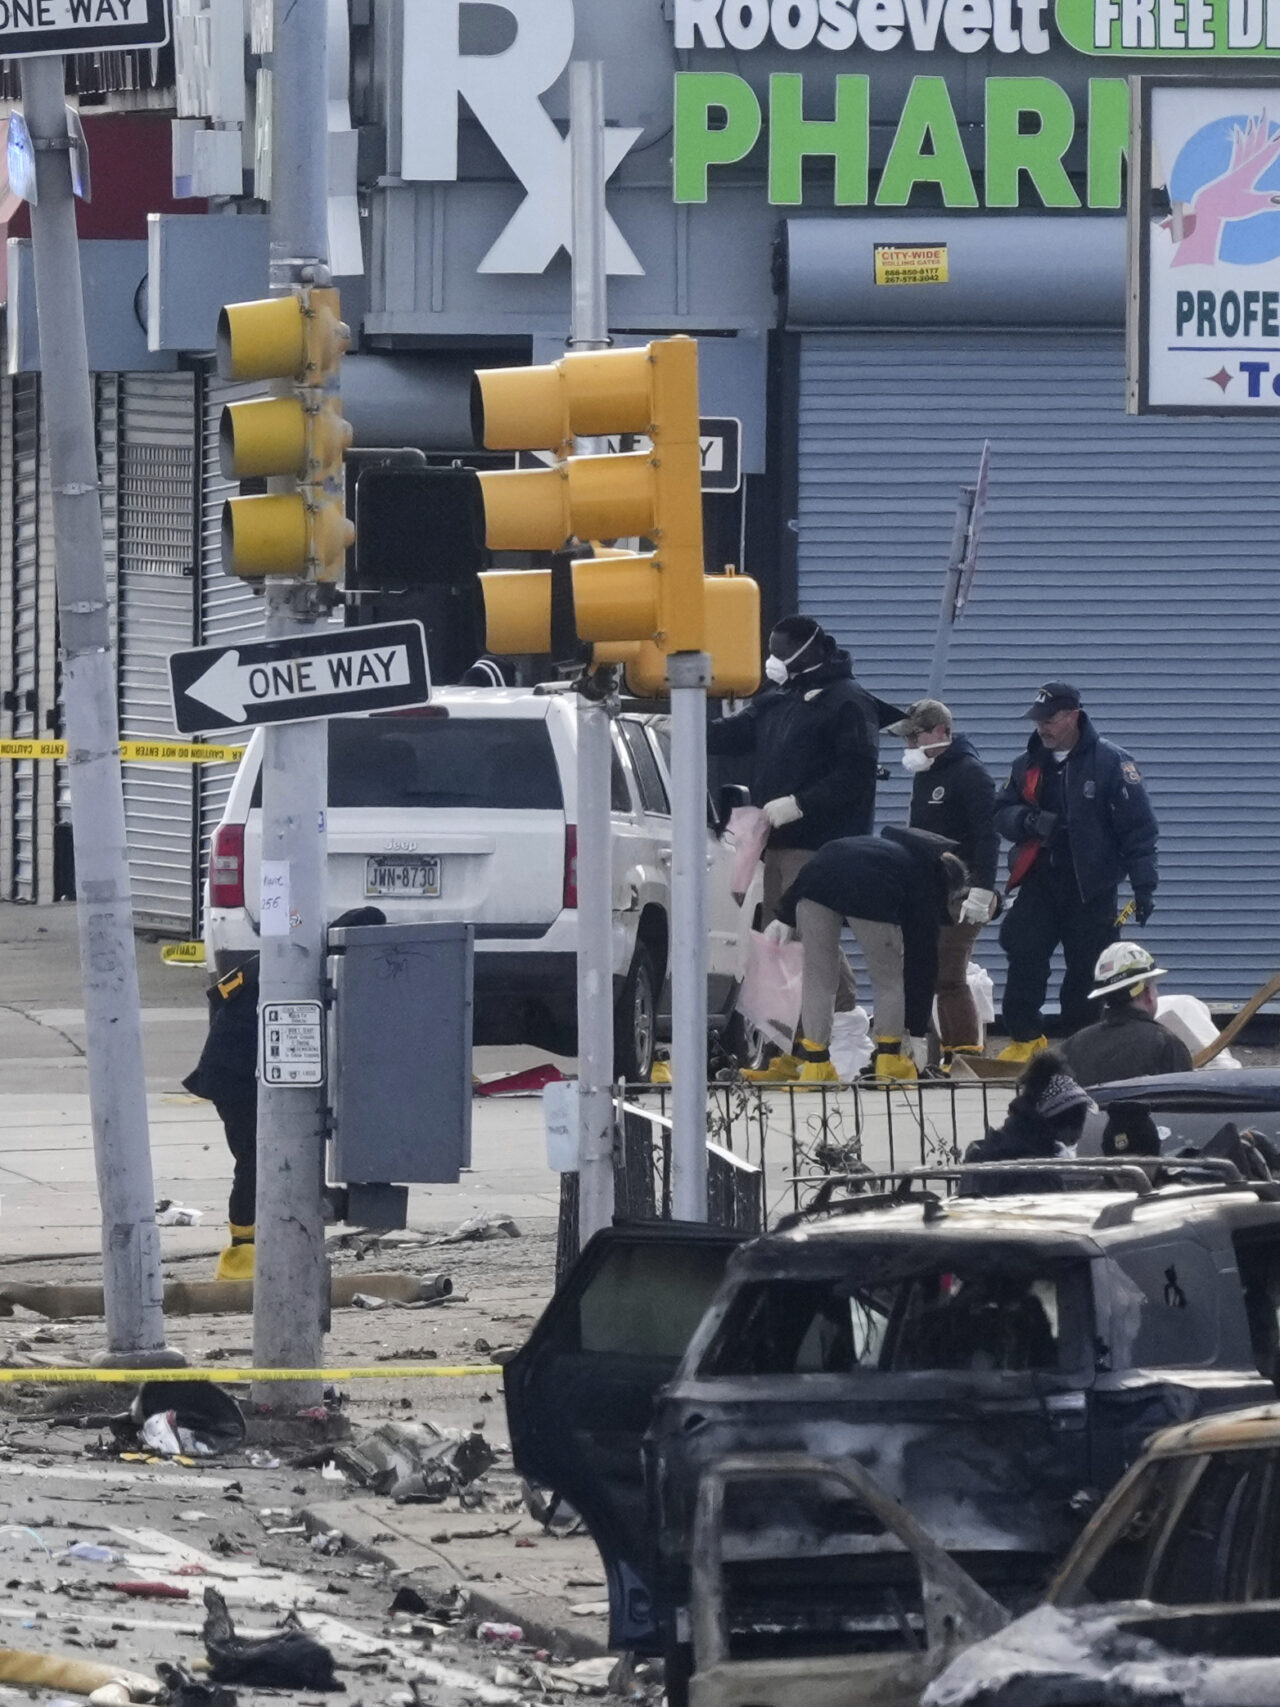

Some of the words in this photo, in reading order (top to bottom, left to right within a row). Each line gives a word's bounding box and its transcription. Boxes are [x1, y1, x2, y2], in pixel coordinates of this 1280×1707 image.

[70, 0, 131, 24] WAY
[674, 0, 1051, 54] Roosevelt
[1093, 0, 1216, 48] FREE
[881, 250, 941, 260] CITY-WIDE
[249, 661, 316, 699] ONE
[327, 650, 396, 688] WAY
[0, 744, 33, 754] CAUTION
[40, 744, 64, 754] ENTER
[135, 746, 159, 757] ENTER
[161, 747, 177, 757] NOT
[177, 748, 189, 757] DO
[190, 748, 224, 759] CAUTION
[384, 840, 418, 852] Jeep
